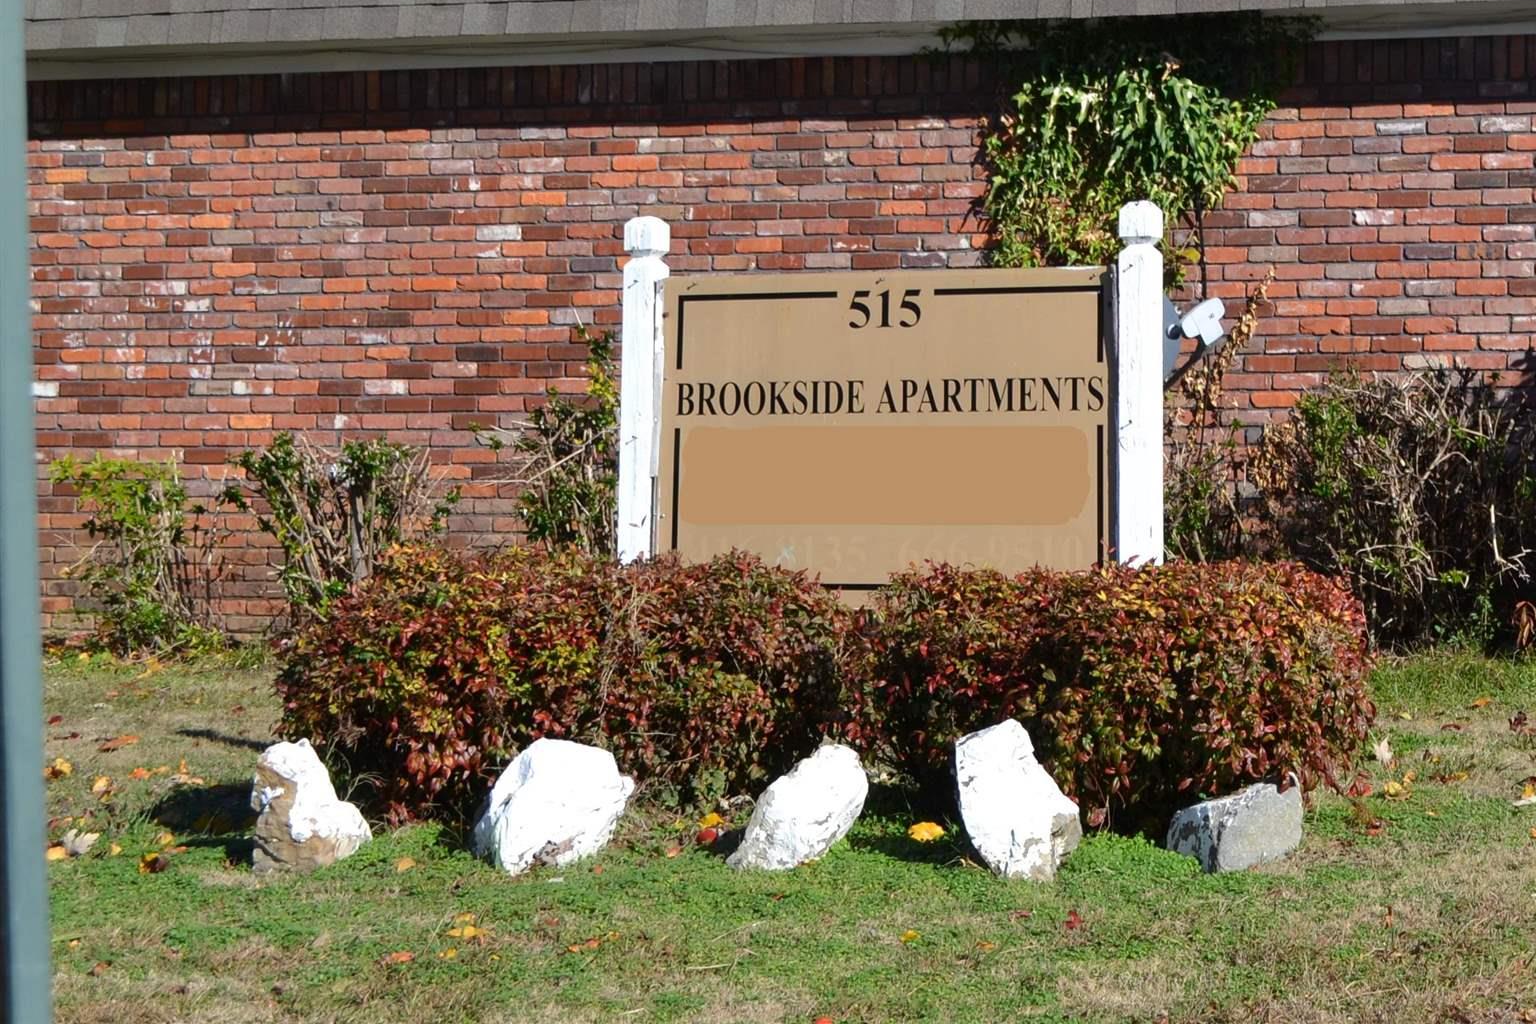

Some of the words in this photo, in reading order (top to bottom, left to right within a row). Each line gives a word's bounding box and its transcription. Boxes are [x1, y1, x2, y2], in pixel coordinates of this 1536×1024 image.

[848, 289, 922, 329] 515
[676, 380, 865, 417] BROOKSIDE
[876, 376, 1104, 415] APARTMENTS
